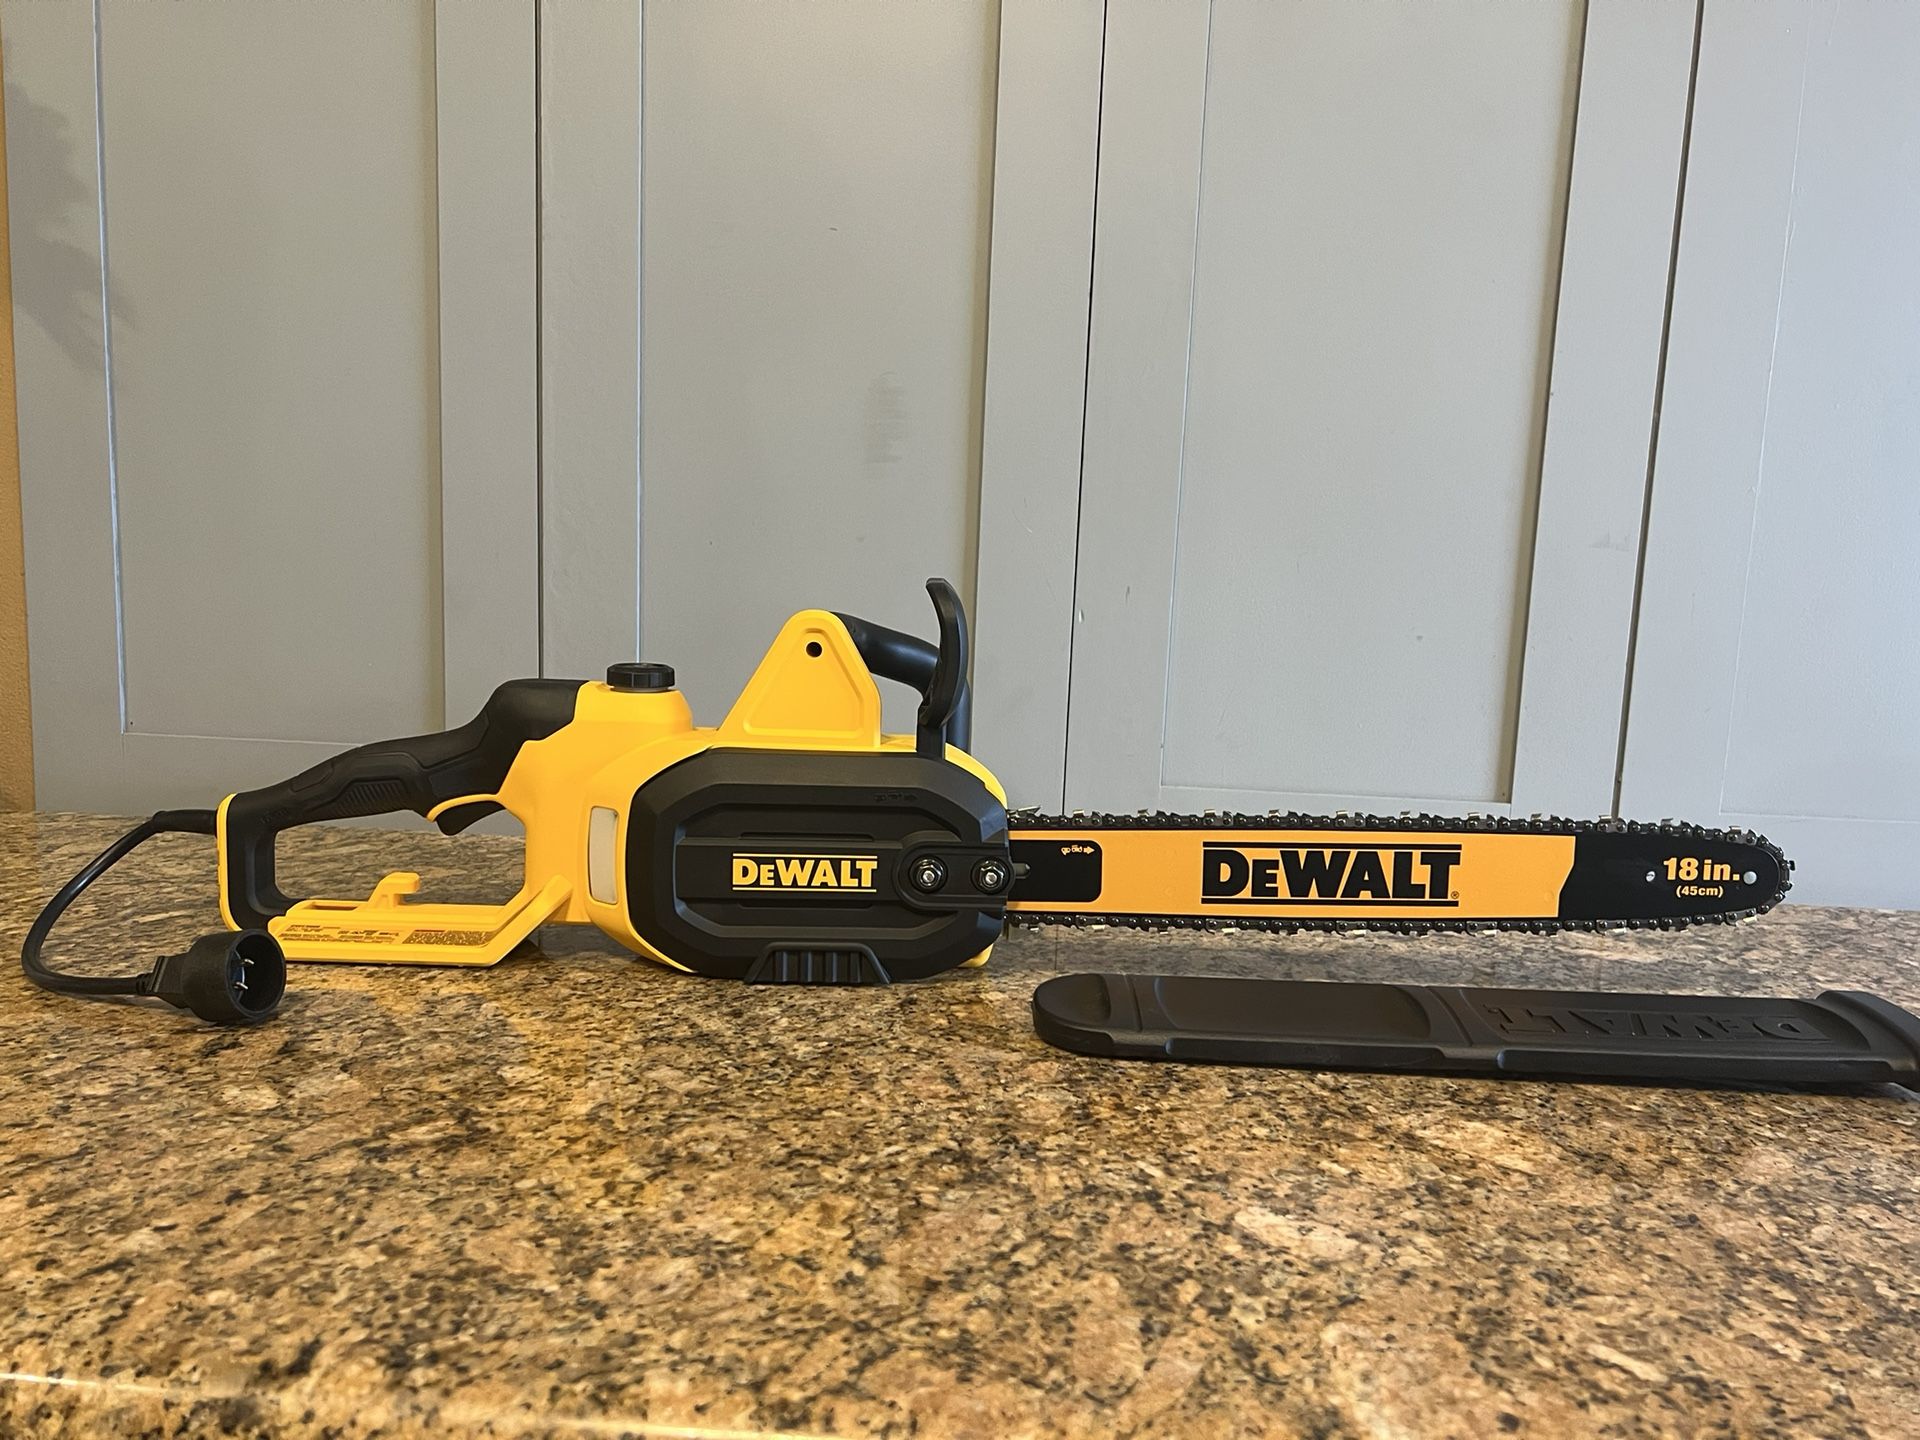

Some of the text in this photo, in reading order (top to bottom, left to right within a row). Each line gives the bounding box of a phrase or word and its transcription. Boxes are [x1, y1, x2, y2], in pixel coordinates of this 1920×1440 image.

[732, 858, 877, 887] DEWALT
[1202, 849, 1461, 899] DEWALT
[1663, 857, 1740, 881] 18 in.
[1676, 885, 1723, 898] (45cm)
